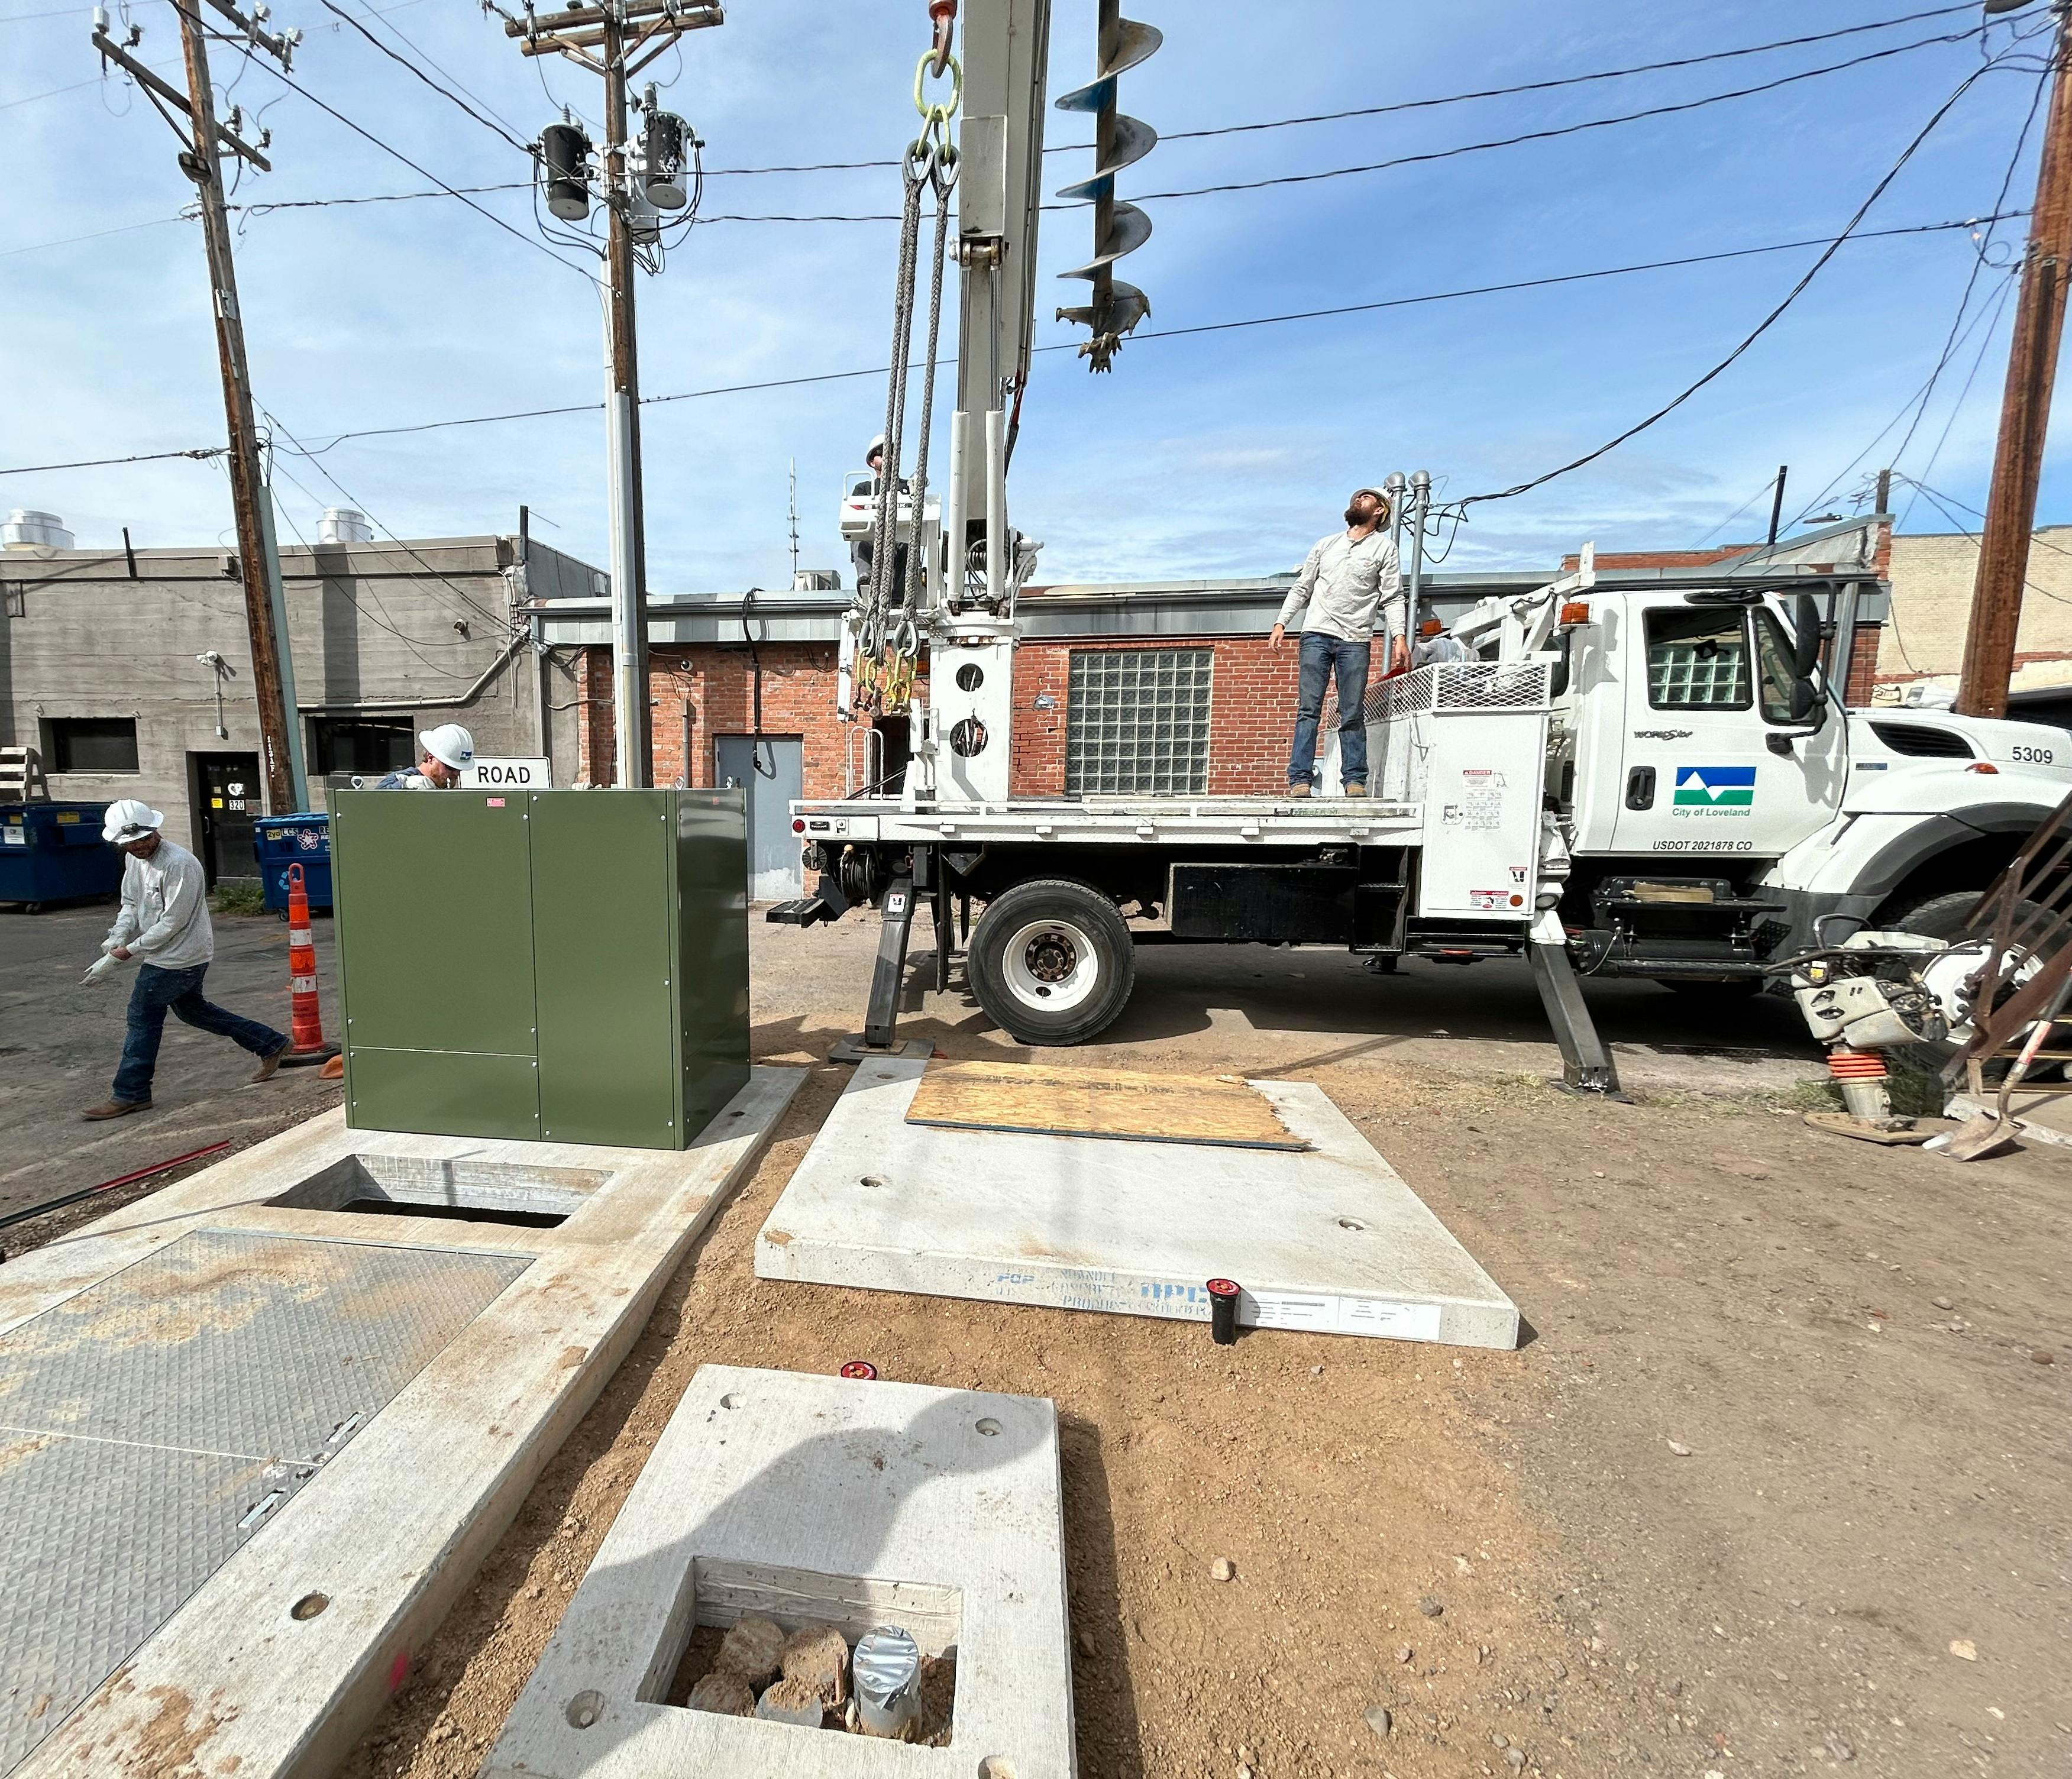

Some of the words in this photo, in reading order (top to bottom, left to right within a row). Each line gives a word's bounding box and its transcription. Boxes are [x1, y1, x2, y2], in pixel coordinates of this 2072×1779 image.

[2012, 746, 2052, 764] 5309
[478, 766, 531, 784] ROAD
[229, 800, 244, 809] 320
[1672, 808, 1691, 817] City
[1693, 808, 1704, 816] of
[1706, 808, 1751, 816] Loveland
[1653, 841, 1690, 850] USDOT
[1692, 841, 1734, 850] 2021878
[1736, 841, 1753, 850] CO
